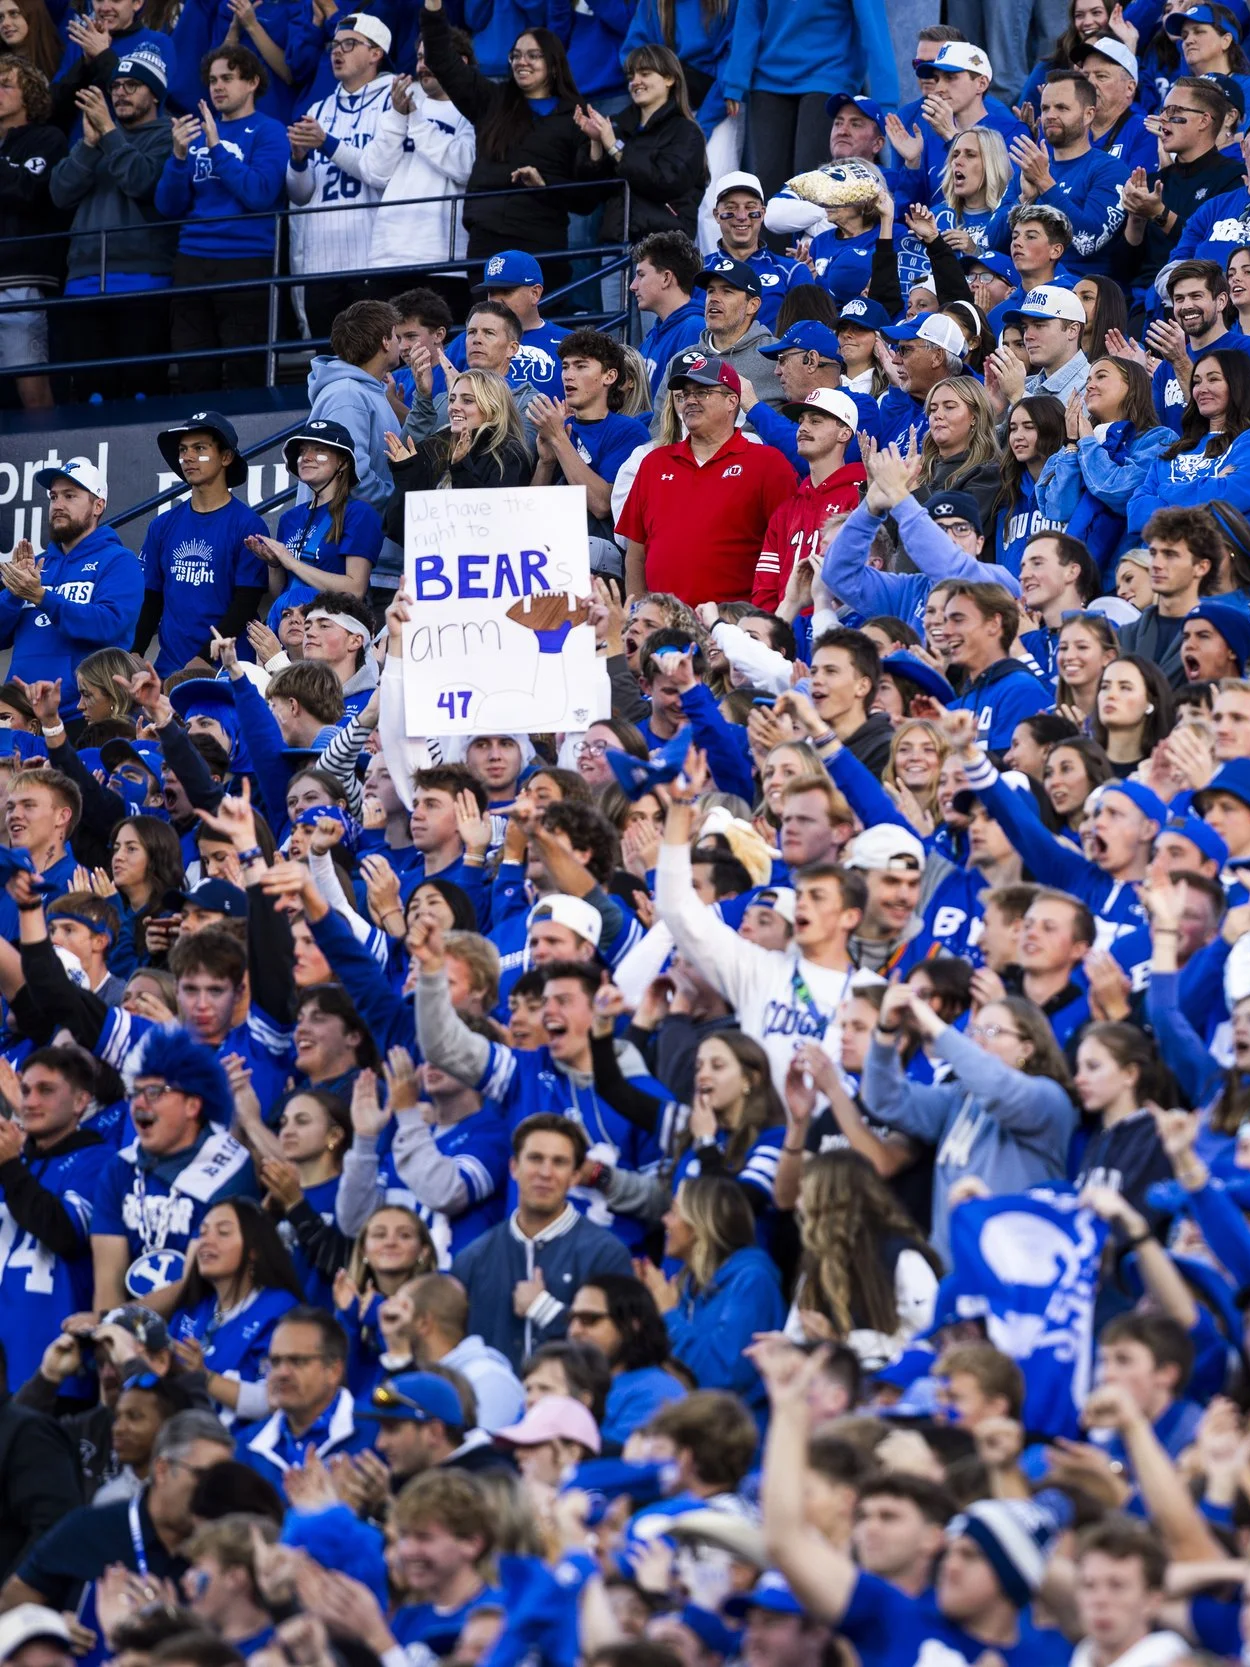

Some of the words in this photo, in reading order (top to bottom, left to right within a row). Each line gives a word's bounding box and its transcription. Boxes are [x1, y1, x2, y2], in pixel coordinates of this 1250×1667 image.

[321, 166, 363, 203] 26
[409, 496, 440, 523] We
[443, 495, 492, 517] have
[505, 492, 537, 513] the
[413, 522, 460, 554] right
[466, 523, 490, 540] to
[185, 566, 215, 587] light
[409, 619, 502, 664] arm
[437, 690, 473, 720] 47
